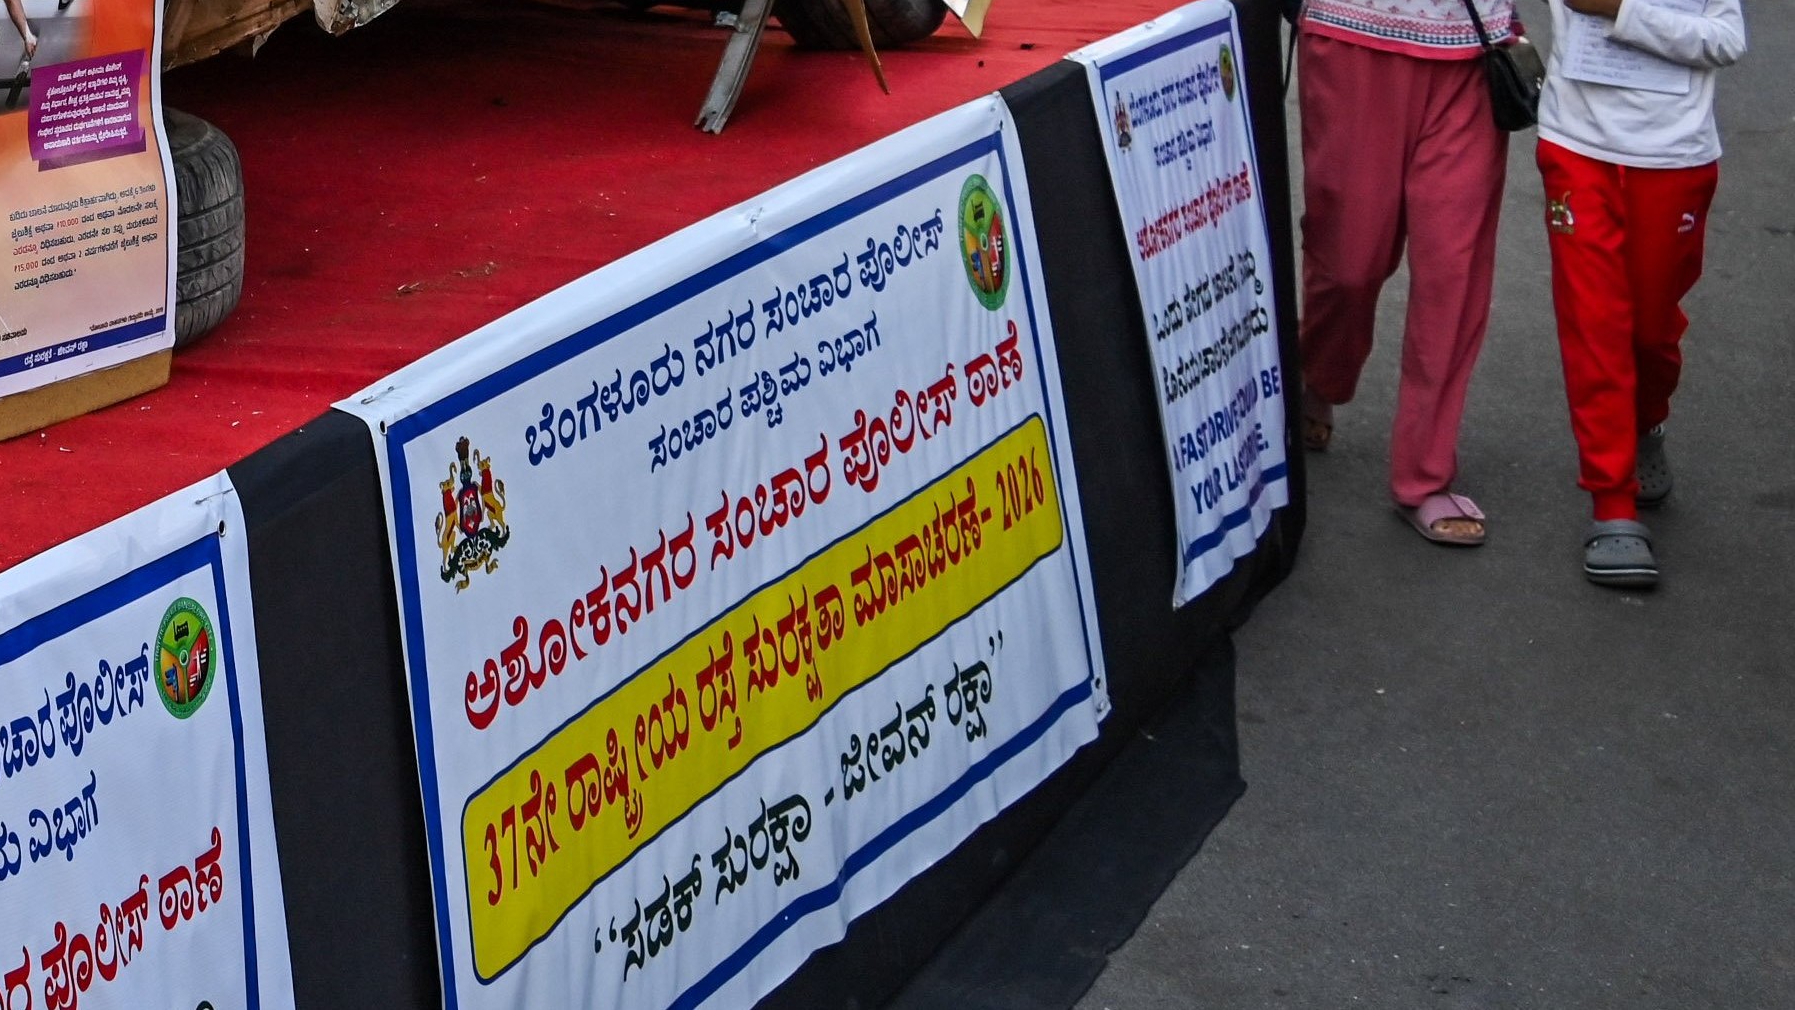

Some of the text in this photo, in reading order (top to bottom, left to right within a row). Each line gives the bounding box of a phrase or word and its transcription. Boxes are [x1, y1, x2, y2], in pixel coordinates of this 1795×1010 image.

[525, 348, 686, 468] ಬೆಂಗಳೂರು
[694, 299, 756, 381] ನಗರ
[763, 252, 853, 342] ಸಂಚಾರ
[856, 208, 947, 294] ಪೊಲೀಸ್
[649, 310, 883, 473] ಸಂಚಾರ ಪಶ್ಚಿಮ ವಿಭಾಗ
[1260, 365, 1282, 400] BE
[465, 319, 1025, 730] ಅಶೋಕನಗರ ಸಂಚಾರ ಪೊಲೀಸ್ ಠಾಣೆ
[1191, 467, 1223, 514] YOUR
[56, 641, 149, 759] ಪೊಲೀಸ್
[484, 769, 560, 907] 37ನೇ
[565, 673, 690, 839] ರಾಷ್ಟ್ರೀಯ
[696, 630, 743, 750] ರಸ್ತೆ
[744, 580, 845, 703] ಸುರಕ್ಷತಾ
[999, 445, 1046, 532] 2026
[29, 770, 99, 863] ವಿಭಾಗ
[711, 793, 812, 906] ಸುರಕ್ಷಾ
[824, 786, 835, 807] -
[840, 693, 936, 801] ಜೀವನ್
[41, 874, 149, 1010] ಪೊಲೀಸ್
[159, 826, 223, 931] ಠಾಣೆ
